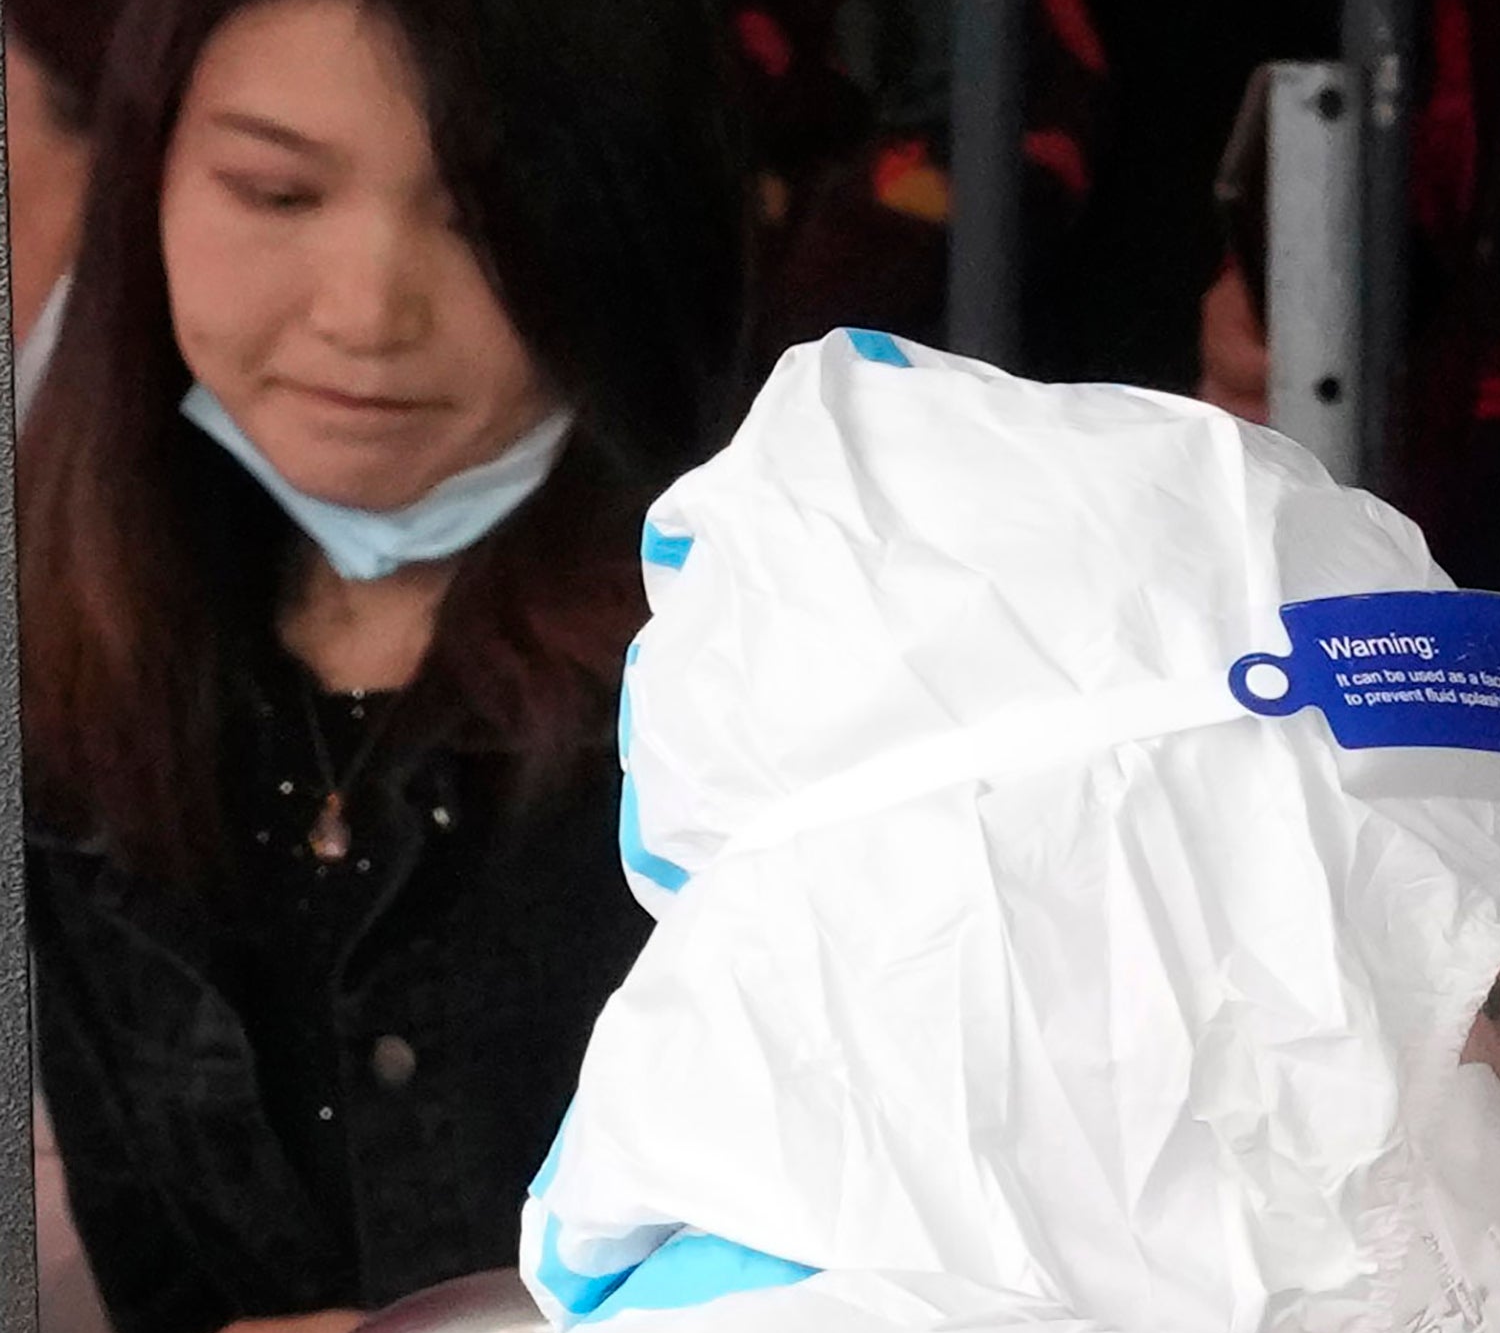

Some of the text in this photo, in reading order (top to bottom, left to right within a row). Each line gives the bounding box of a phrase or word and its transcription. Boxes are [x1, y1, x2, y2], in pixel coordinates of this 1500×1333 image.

[1318, 632, 1440, 660] Warning:
[1335, 672, 1351, 687] It
[1352, 671, 1382, 686] can
[1383, 669, 1406, 683] be
[1408, 669, 1445, 683] used
[1448, 671, 1467, 684] as
[1468, 672, 1479, 685] a
[1344, 692, 1363, 706] to
[1364, 688, 1425, 707] prevent
[1425, 687, 1457, 703] fluid
